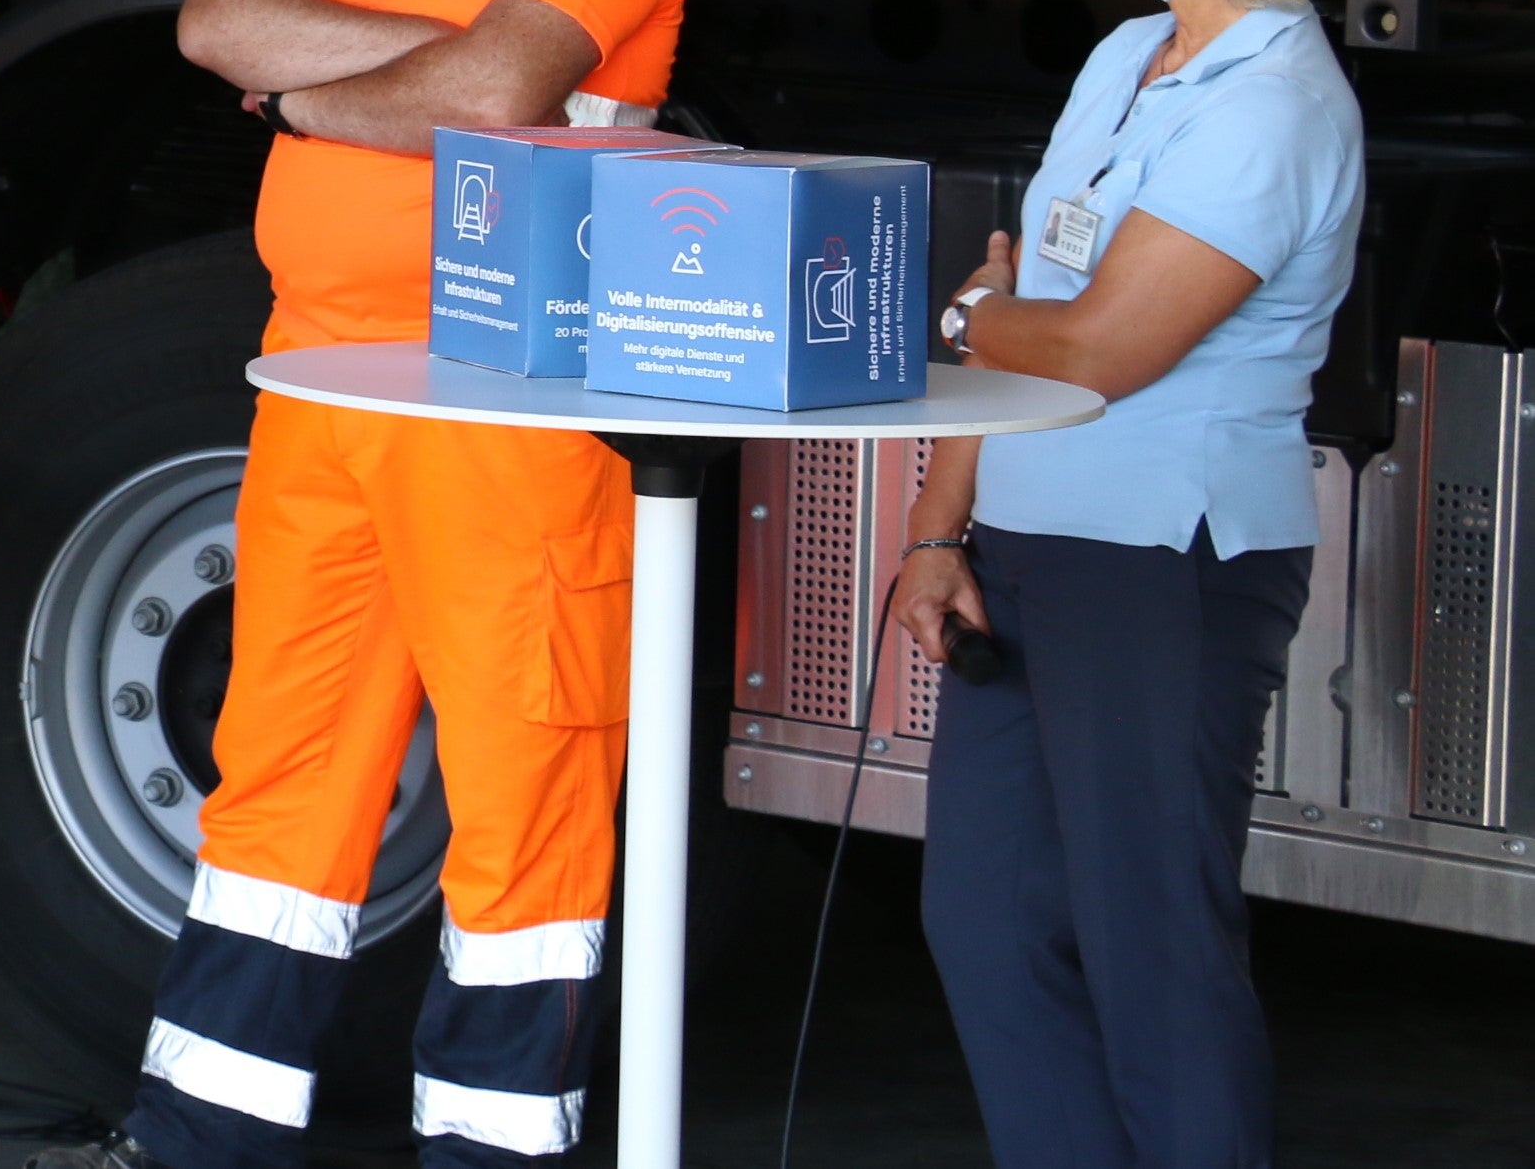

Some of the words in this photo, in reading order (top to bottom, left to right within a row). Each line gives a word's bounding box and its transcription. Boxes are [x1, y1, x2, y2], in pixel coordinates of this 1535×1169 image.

[869, 195, 881, 273] moderne
[896, 185, 908, 321] Sicherheitsmanagement
[434, 256, 463, 275] Sichere
[463, 264, 479, 279] und
[479, 267, 516, 286] moderne
[444, 280, 502, 305] Infrastrukturen
[607, 289, 643, 308] Volle
[645, 293, 749, 318] Intermodalität
[751, 302, 764, 319] &
[868, 278, 877, 311] und
[881, 223, 894, 356] Infrastrukturen
[555, 327, 570, 338] 20
[596, 311, 776, 343] Digitalisierungsoffensive
[897, 325, 905, 347] und
[623, 342, 648, 355] Mehr
[650, 344, 685, 360] digitale
[686, 348, 724, 363] Dienste
[725, 352, 745, 365] und
[868, 315, 879, 381] Sichere
[635, 361, 675, 375] stärkere
[675, 363, 732, 383] Vernetzung
[897, 353, 905, 383] Erhalt
